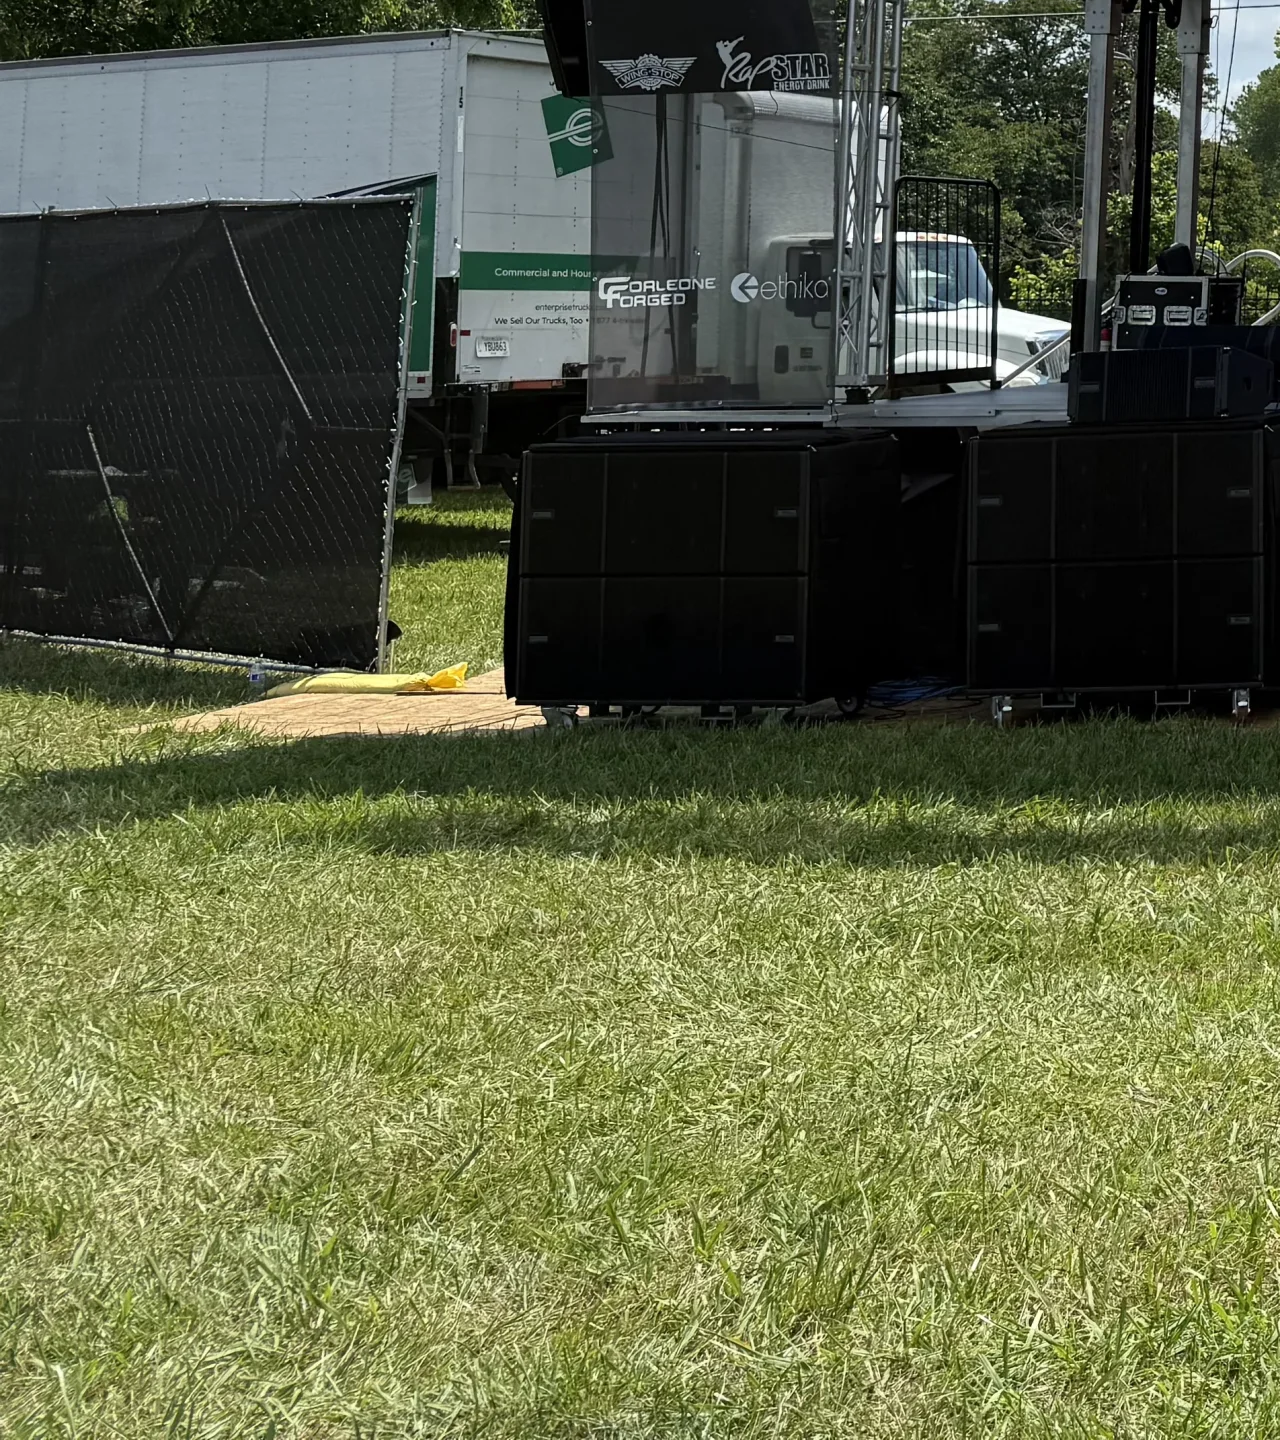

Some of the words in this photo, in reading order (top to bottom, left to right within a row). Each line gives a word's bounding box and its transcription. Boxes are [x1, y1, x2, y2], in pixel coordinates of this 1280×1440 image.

[771, 53, 832, 81] STAR
[774, 81, 805, 91] ENERGY
[806, 81, 831, 91] DRINK
[494, 268, 550, 278] Commercial
[552, 269, 569, 278] and
[760, 272, 829, 300] ethika
[494, 317, 508, 325] We
[510, 317, 523, 325] Sell
[525, 317, 540, 325] Our
[542, 317, 568, 326] Trucks,
[570, 317, 583, 325] Too
